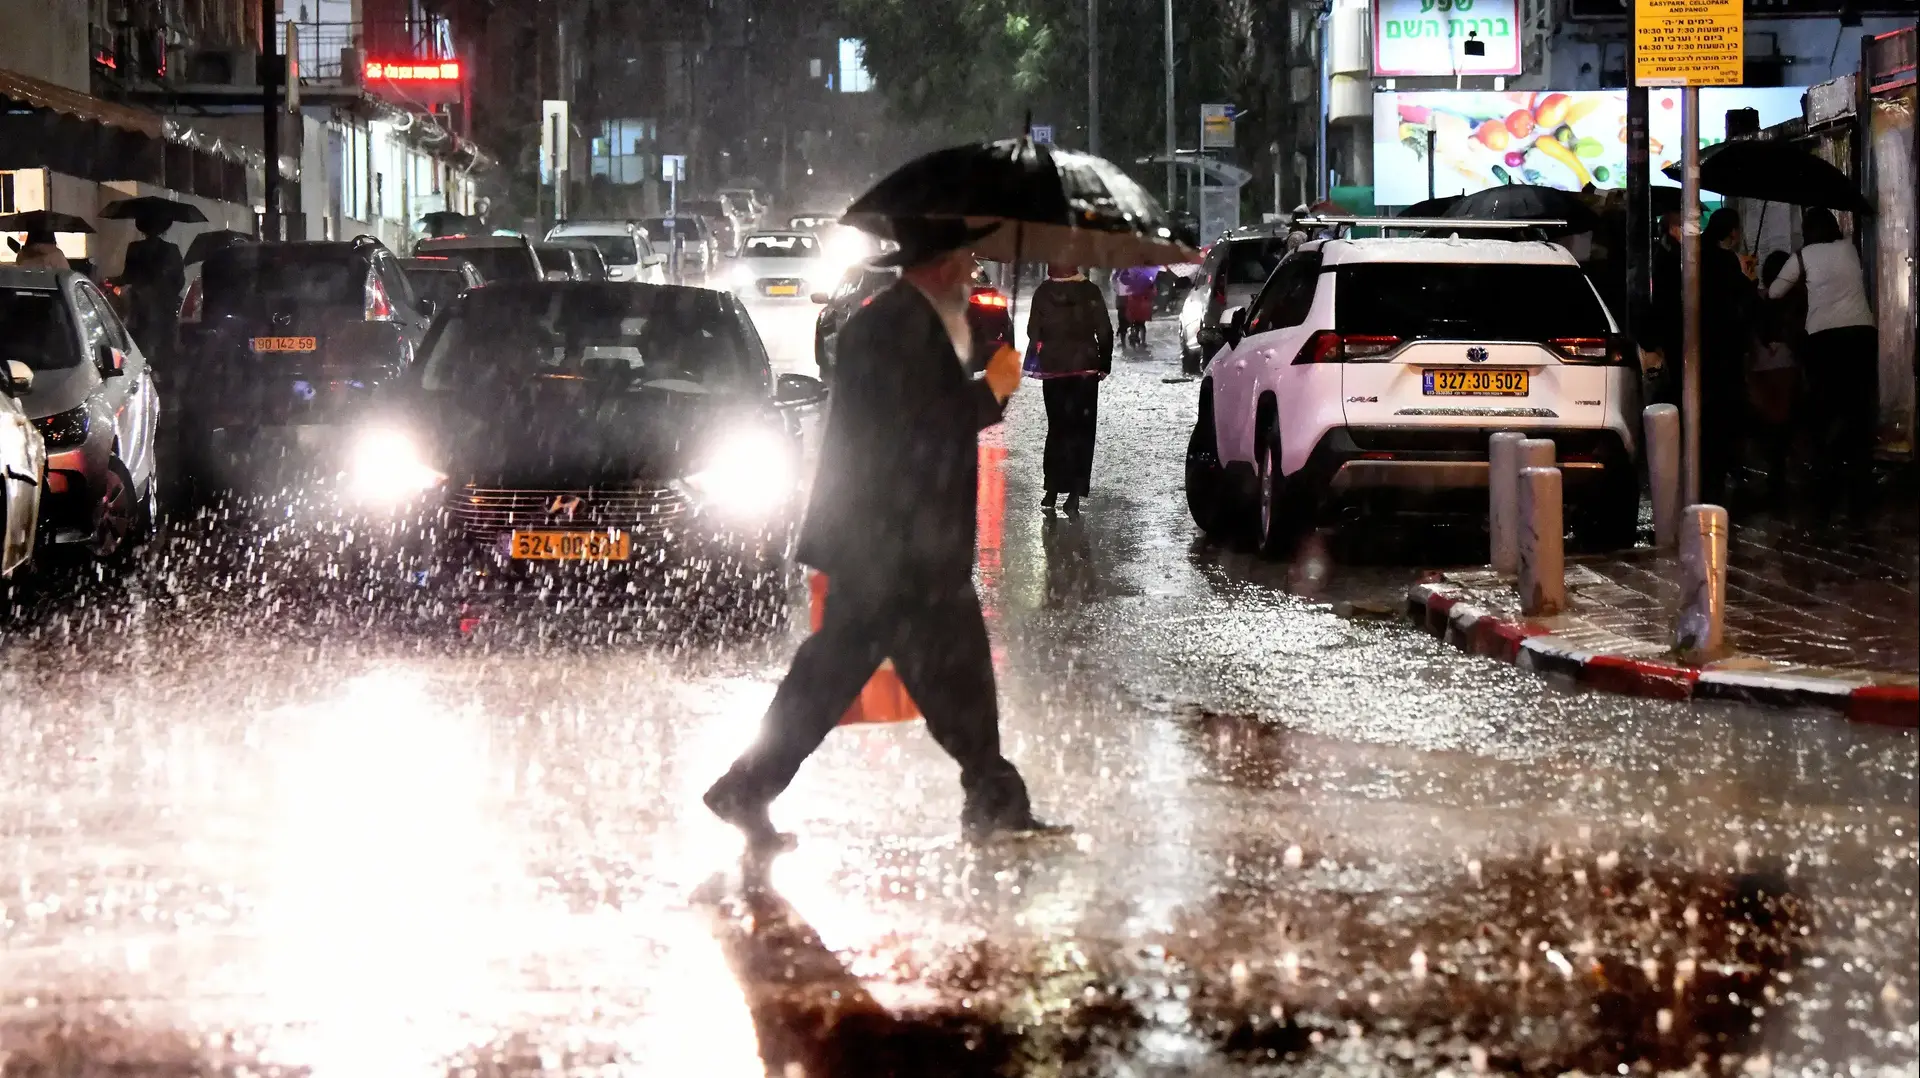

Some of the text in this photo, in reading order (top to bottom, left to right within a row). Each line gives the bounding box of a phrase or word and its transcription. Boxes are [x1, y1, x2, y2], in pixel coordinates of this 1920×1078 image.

[1386, 19, 1439, 38] השם
[1727, 26, 1738, 34] בין
[1727, 42, 1738, 50] בין
